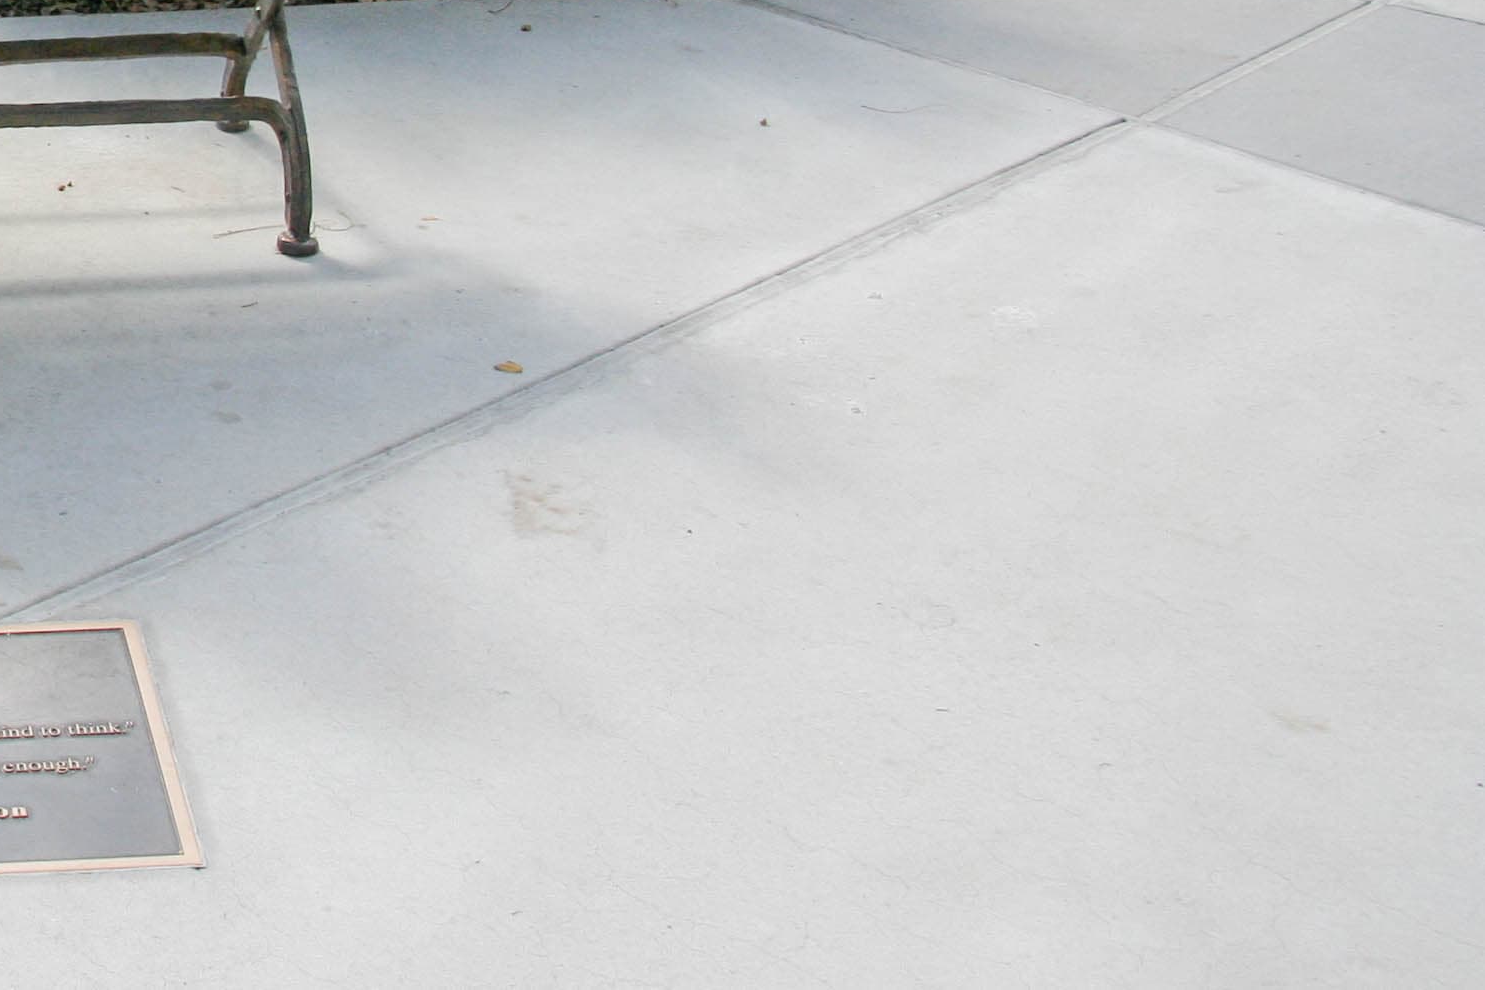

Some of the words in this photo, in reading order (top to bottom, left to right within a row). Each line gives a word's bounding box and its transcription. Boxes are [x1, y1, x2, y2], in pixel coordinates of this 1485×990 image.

[41, 725, 61, 738] to
[67, 720, 134, 737] think."
[2, 755, 95, 774] enough."
